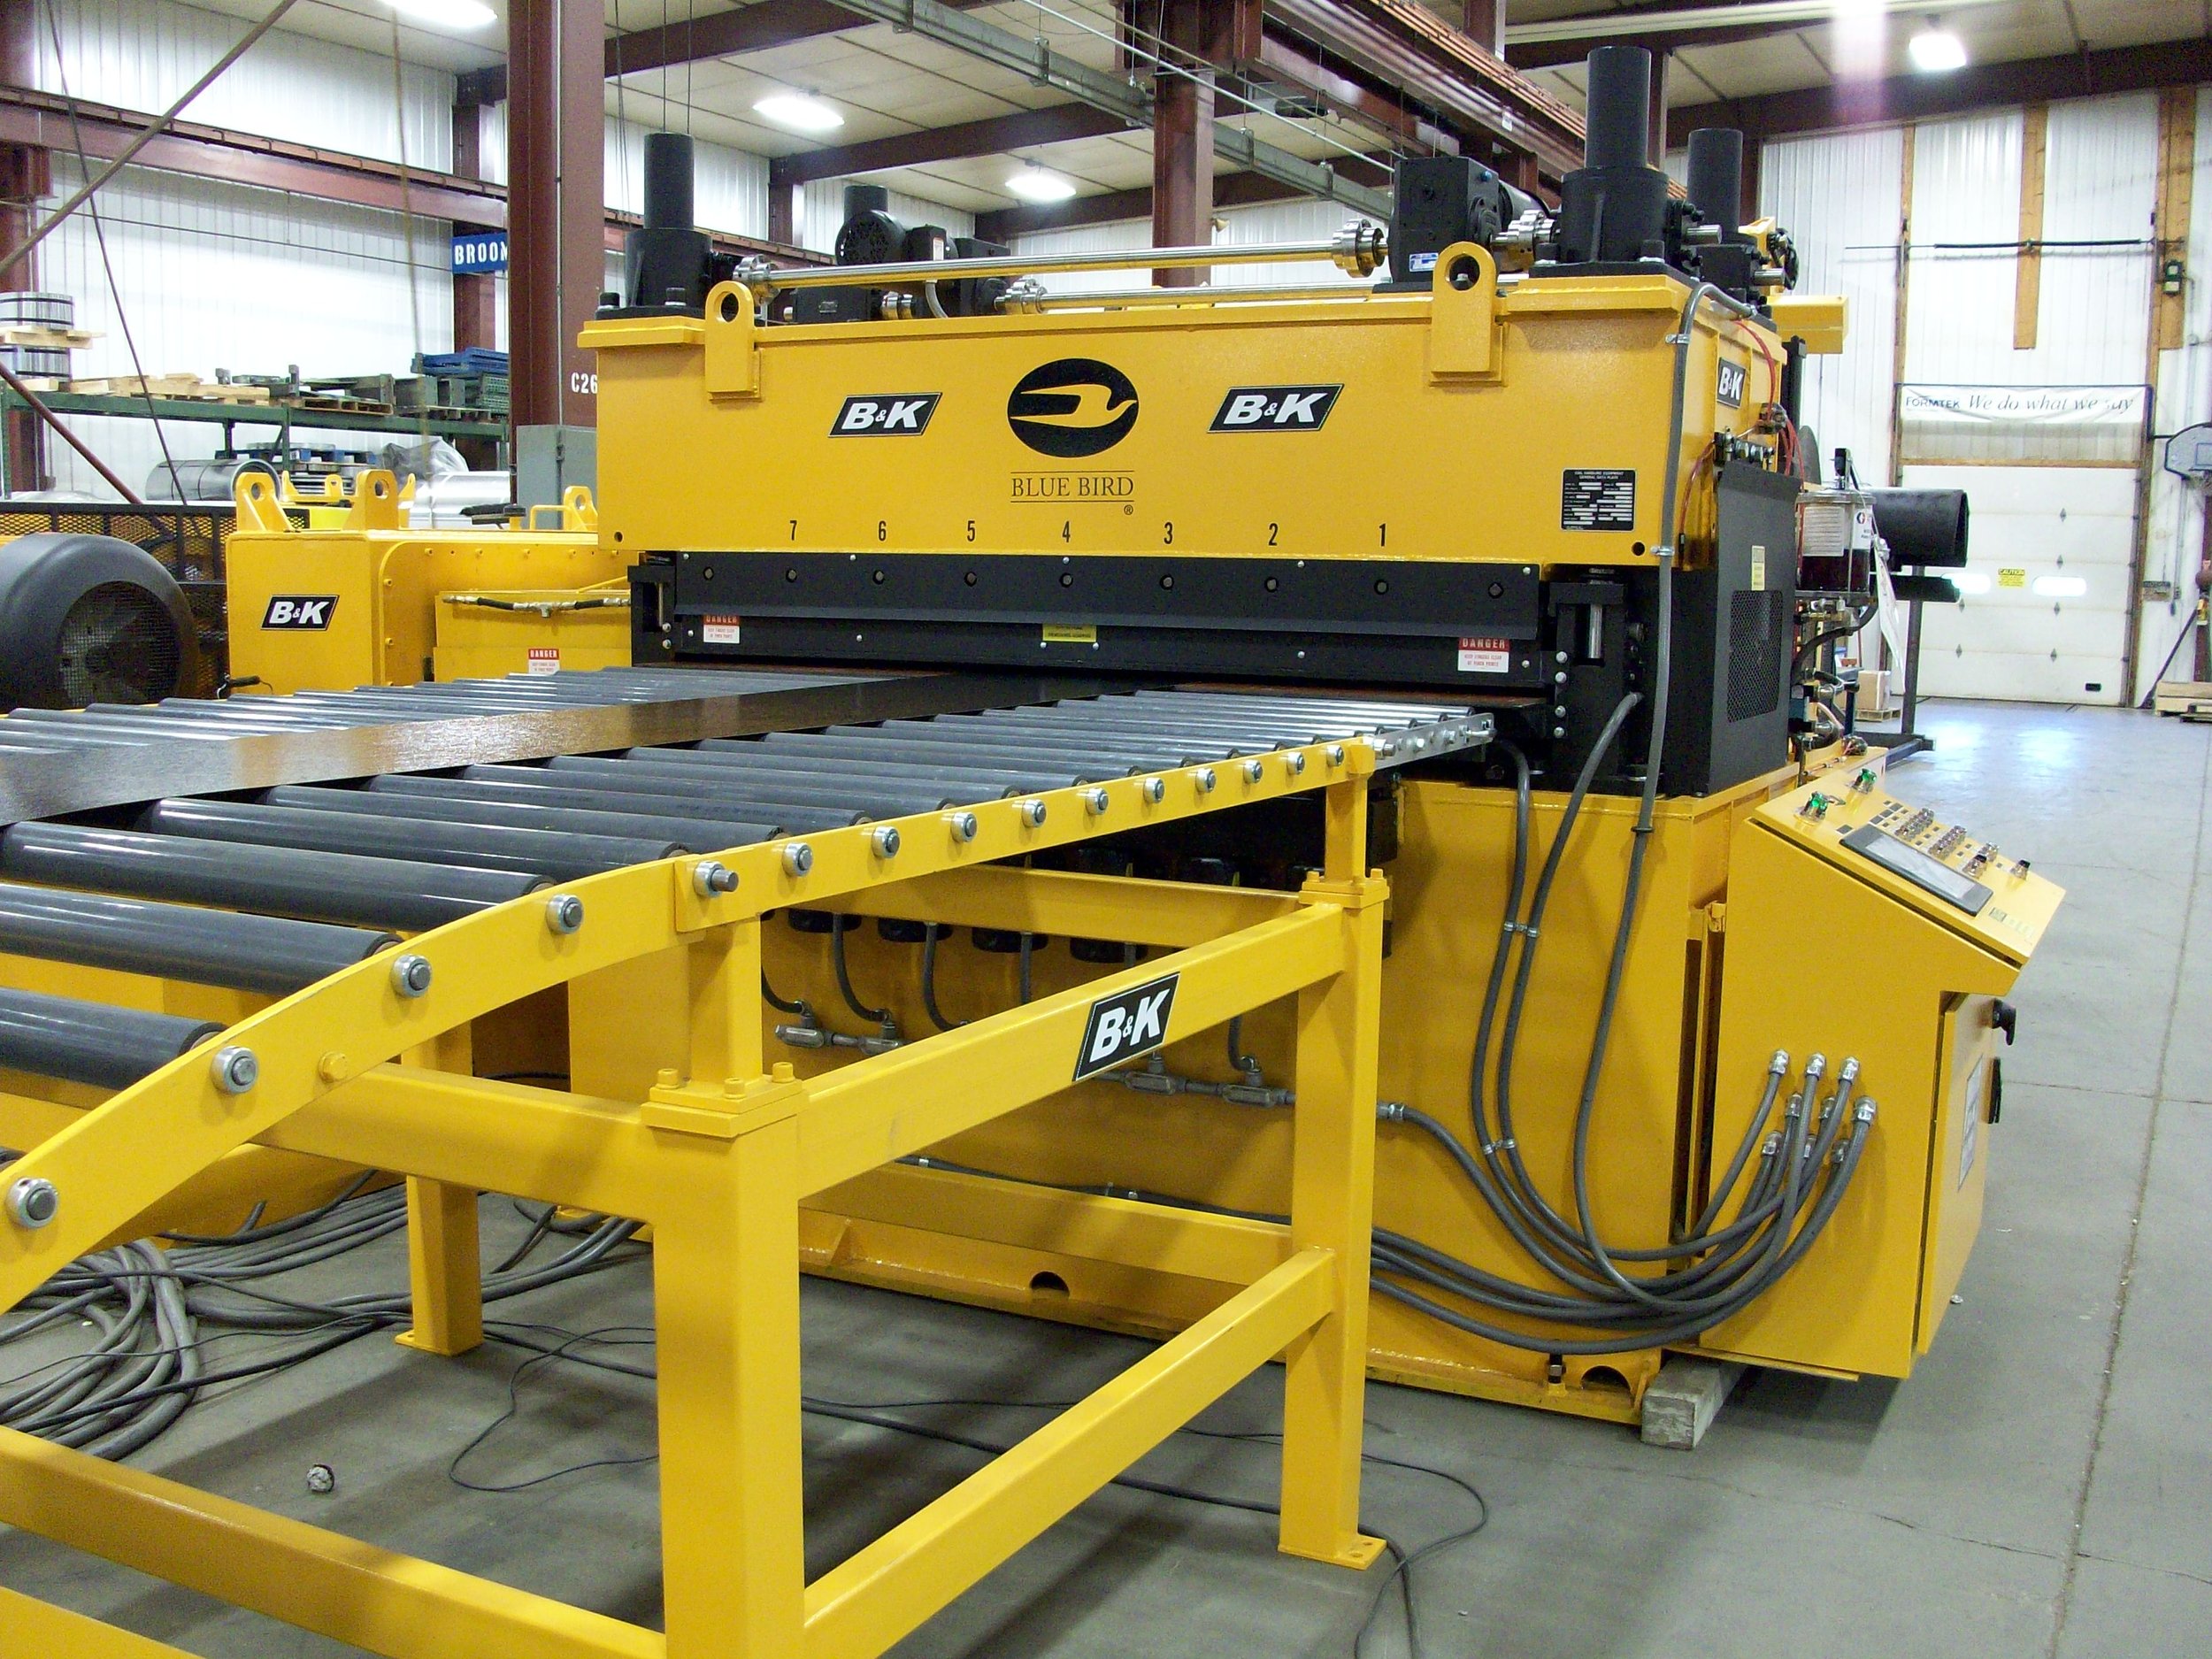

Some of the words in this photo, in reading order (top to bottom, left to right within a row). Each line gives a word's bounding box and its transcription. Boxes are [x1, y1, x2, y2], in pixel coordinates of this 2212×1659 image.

[571, 372, 598, 395] C26
[1718, 366, 1744, 401] B&K
[1223, 392, 1328, 426] B&K
[1906, 396, 1961, 409] FORMTEK
[1970, 395, 1993, 409] We
[1997, 395, 2019, 410] do
[2026, 395, 2068, 411] what
[2074, 399, 2098, 410] we
[841, 400, 929, 431] B&K
[1011, 477, 1071, 497] BLUE
[1077, 476, 1134, 497] BIRD
[789, 519, 798, 541] 7
[878, 520, 887, 541] 6
[966, 520, 976, 542] 5
[1062, 520, 1071, 543] 4
[1164, 521, 1173, 545] 3
[1268, 523, 1279, 546] 2
[1379, 523, 1386, 547] 1
[268, 601, 330, 625] B&K
[530, 649, 557, 658] DANGER
[1462, 637, 1505, 649] DANGER
[1089, 988, 1171, 1064] B&K
